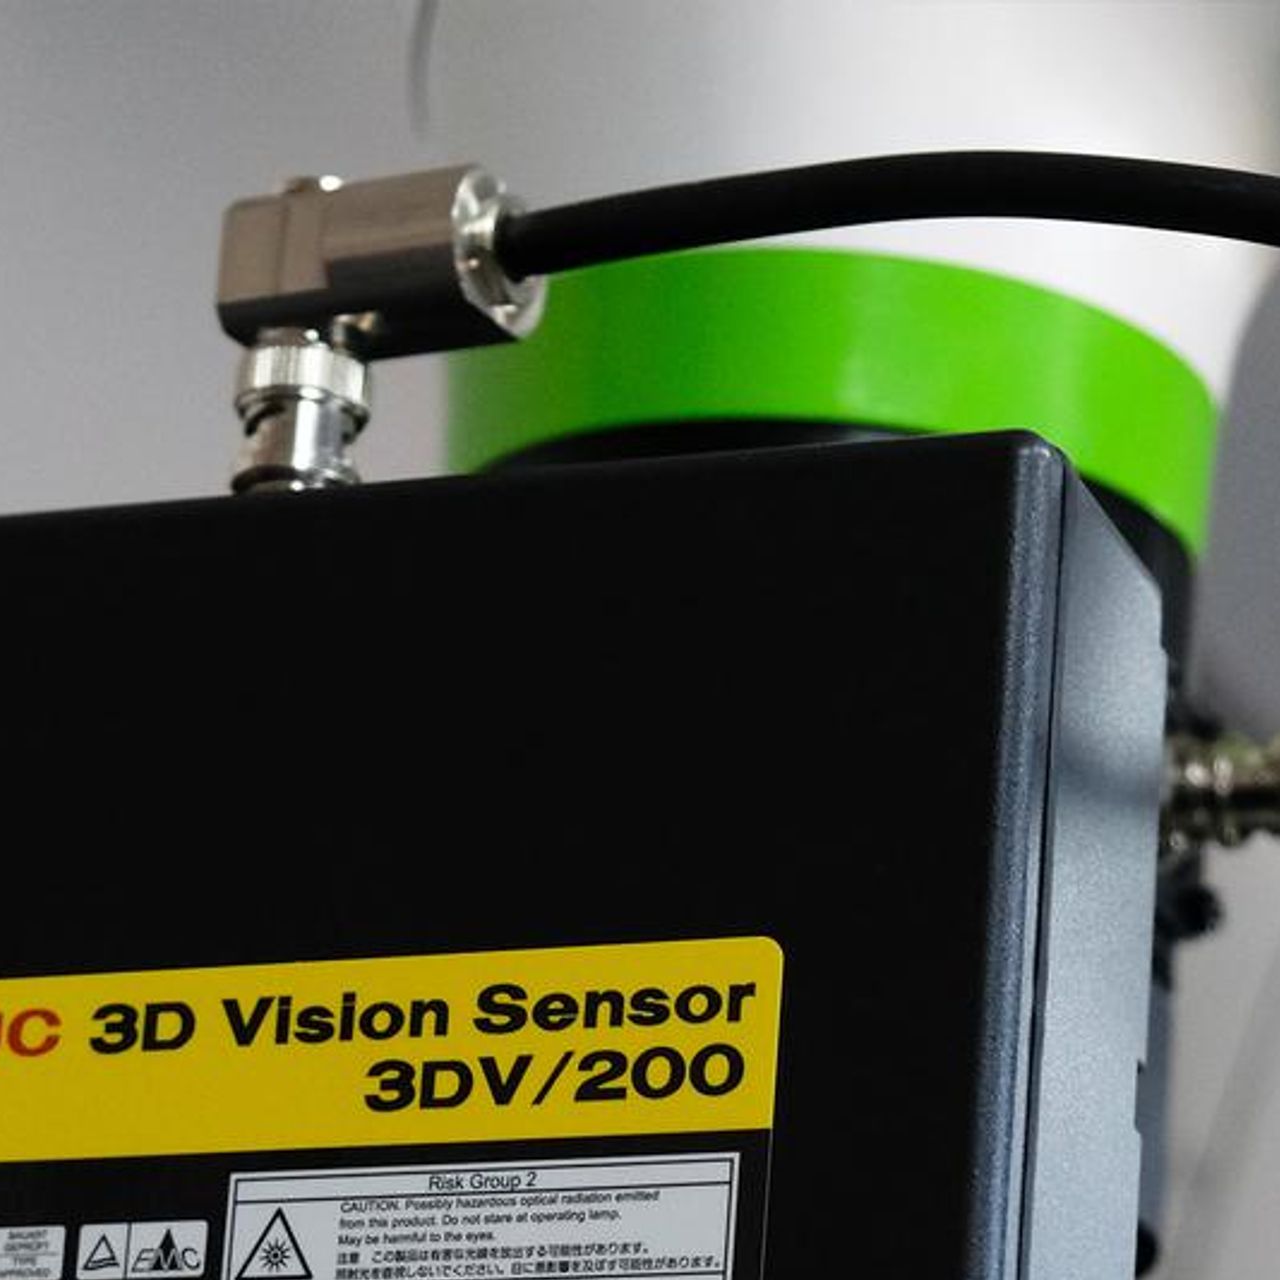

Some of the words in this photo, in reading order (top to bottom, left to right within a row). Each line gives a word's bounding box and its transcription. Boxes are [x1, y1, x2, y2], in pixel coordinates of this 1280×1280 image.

[89, 1001, 196, 1055] 3D
[222, 992, 449, 1046] Vision
[472, 982, 757, 1034] Sensor
[364, 1043, 745, 1112] 3DV/200
[428, 1175, 464, 1191] Risk
[470, 1173, 522, 1193] Group
[526, 1171, 538, 1187] 2
[405, 1198, 454, 1211] Possibly
[456, 1196, 517, 1208] hazardous
[520, 1193, 559, 1207] optical
[561, 1191, 612, 1204] radiation
[614, 1190, 661, 1202] emitted
[339, 1217, 365, 1229] from
[369, 1216, 388, 1228] this
[441, 1214, 458, 1225] Do
[461, 1213, 481, 1225] not
[484, 1213, 513, 1225] stare
[516, 1212, 528, 1223] at
[530, 1209, 586, 1223] operating
[588, 1209, 621, 1221] lamp.
[337, 1235, 361, 1246] May
[364, 1234, 379, 1245] be
[383, 1232, 426, 1244] harmful
[429, 1232, 441, 1243] to
[443, 1231, 463, 1242] the
[465, 1231, 495, 1243] eyes.
